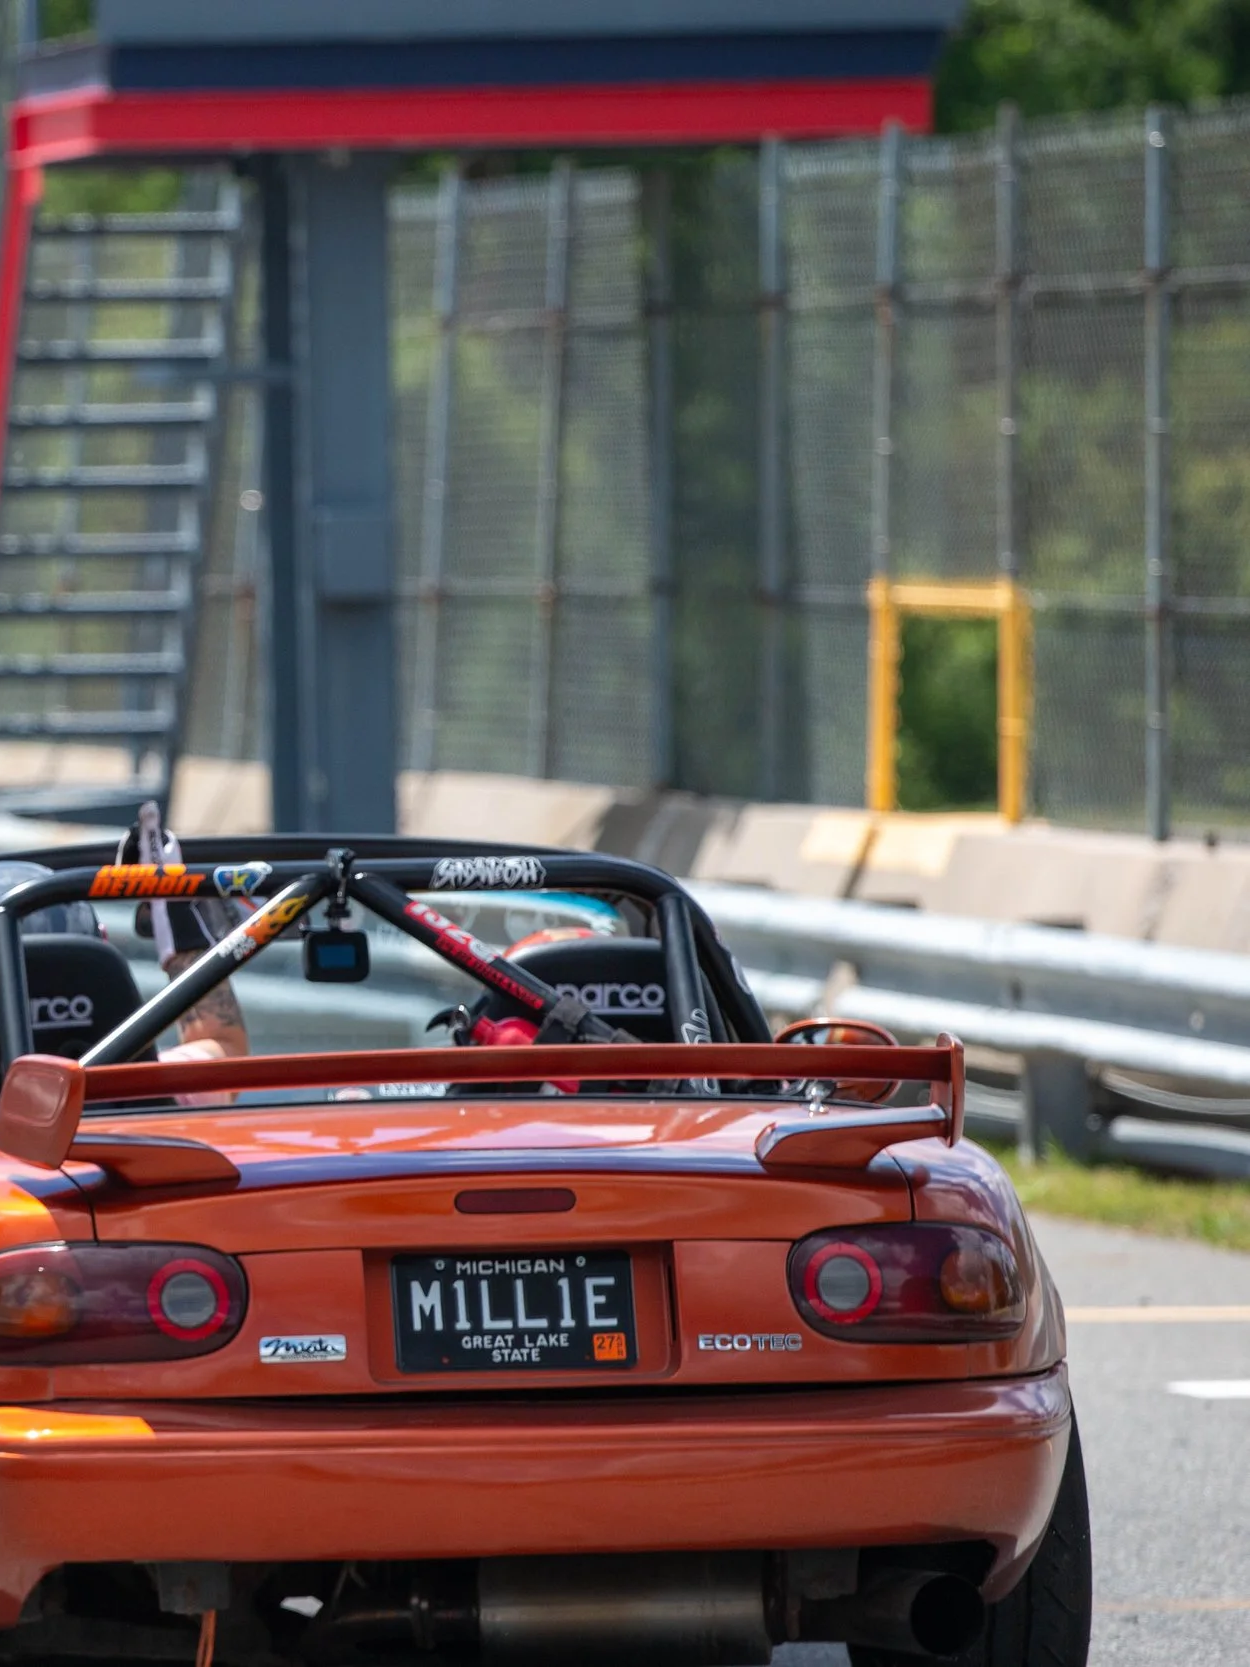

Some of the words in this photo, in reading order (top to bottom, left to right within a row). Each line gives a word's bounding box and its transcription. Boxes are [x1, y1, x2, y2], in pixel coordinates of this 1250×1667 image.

[88, 873, 206, 897] DETROIT
[554, 983, 666, 1014] parco
[456, 1259, 565, 1275] MICHIGAN
[410, 1277, 618, 1331] M1LL1E
[264, 1337, 343, 1357] Miata
[461, 1335, 515, 1349] GREAT
[524, 1333, 569, 1348] LAKE
[596, 1335, 617, 1350] 27
[698, 1333, 803, 1352] ECOTEC
[491, 1348, 541, 1363] STATE
